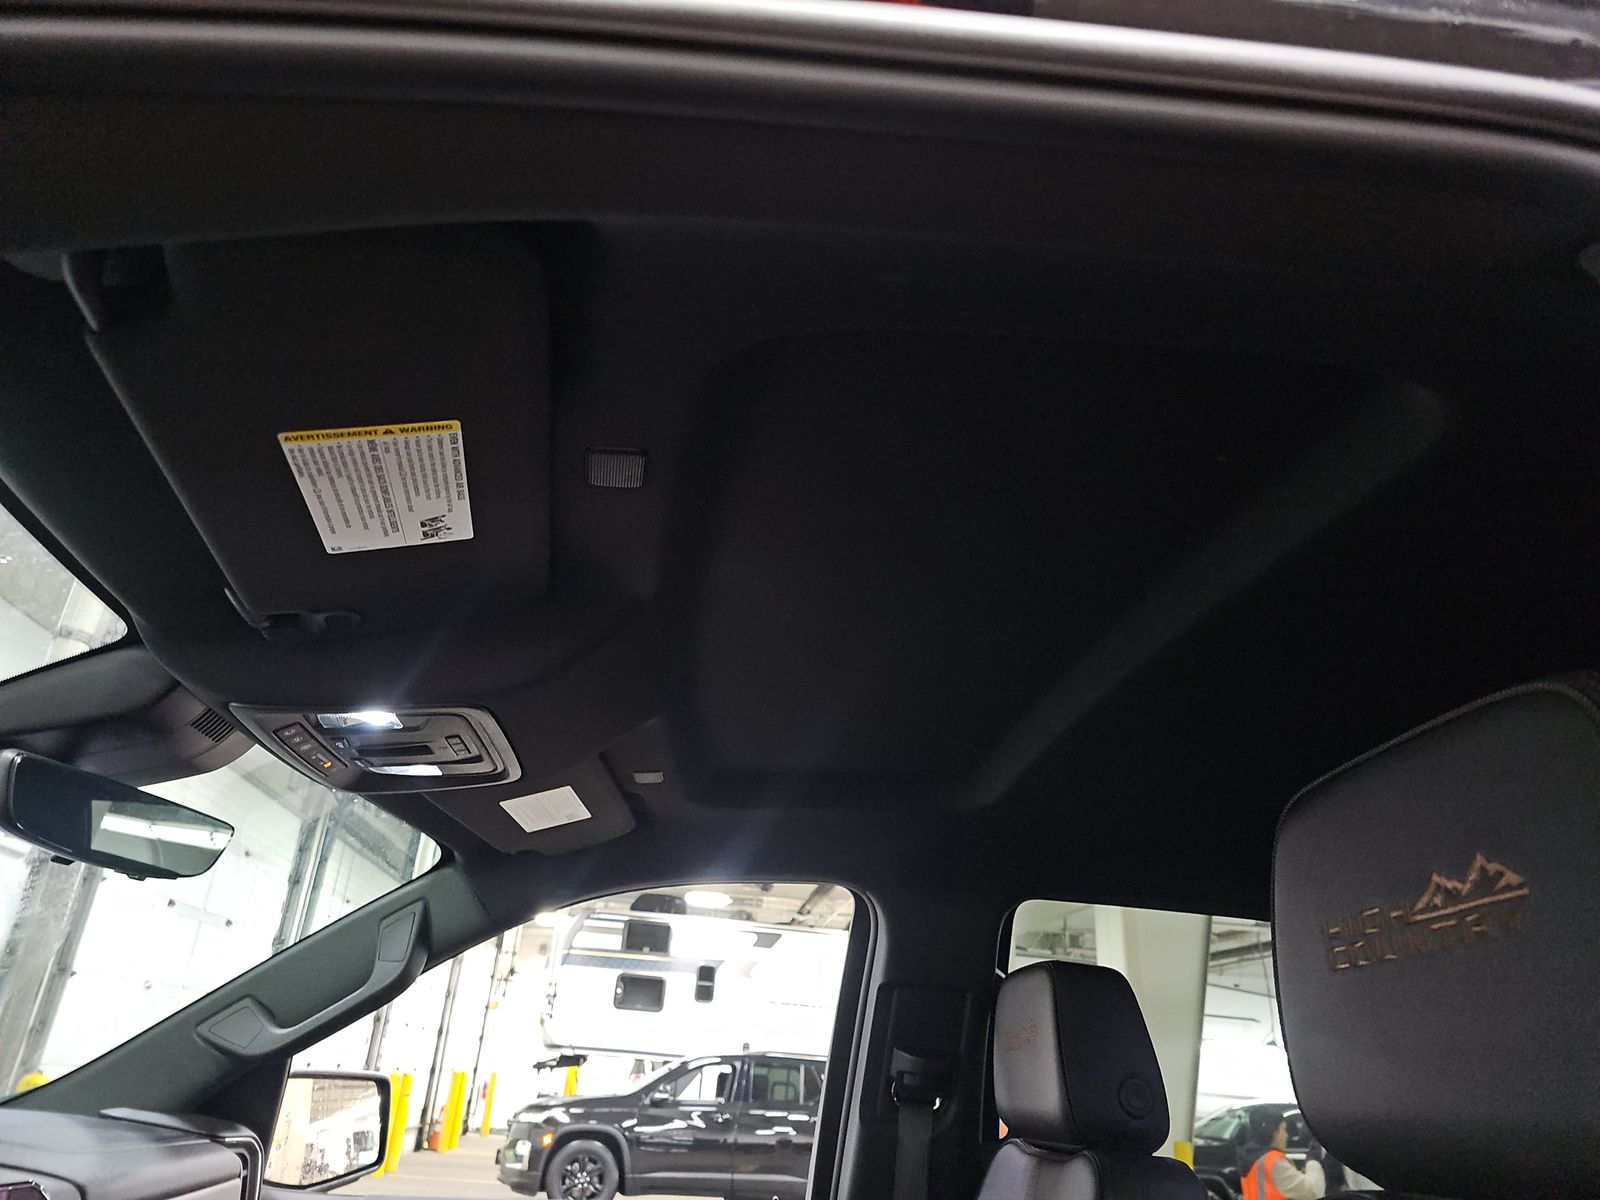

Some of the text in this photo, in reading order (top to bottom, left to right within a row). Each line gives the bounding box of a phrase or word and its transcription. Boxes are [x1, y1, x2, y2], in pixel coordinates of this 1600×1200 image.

[284, 423, 453, 442] AVERTISSEMENT WARNING
[1327, 910, 1520, 972] COUNTRY
